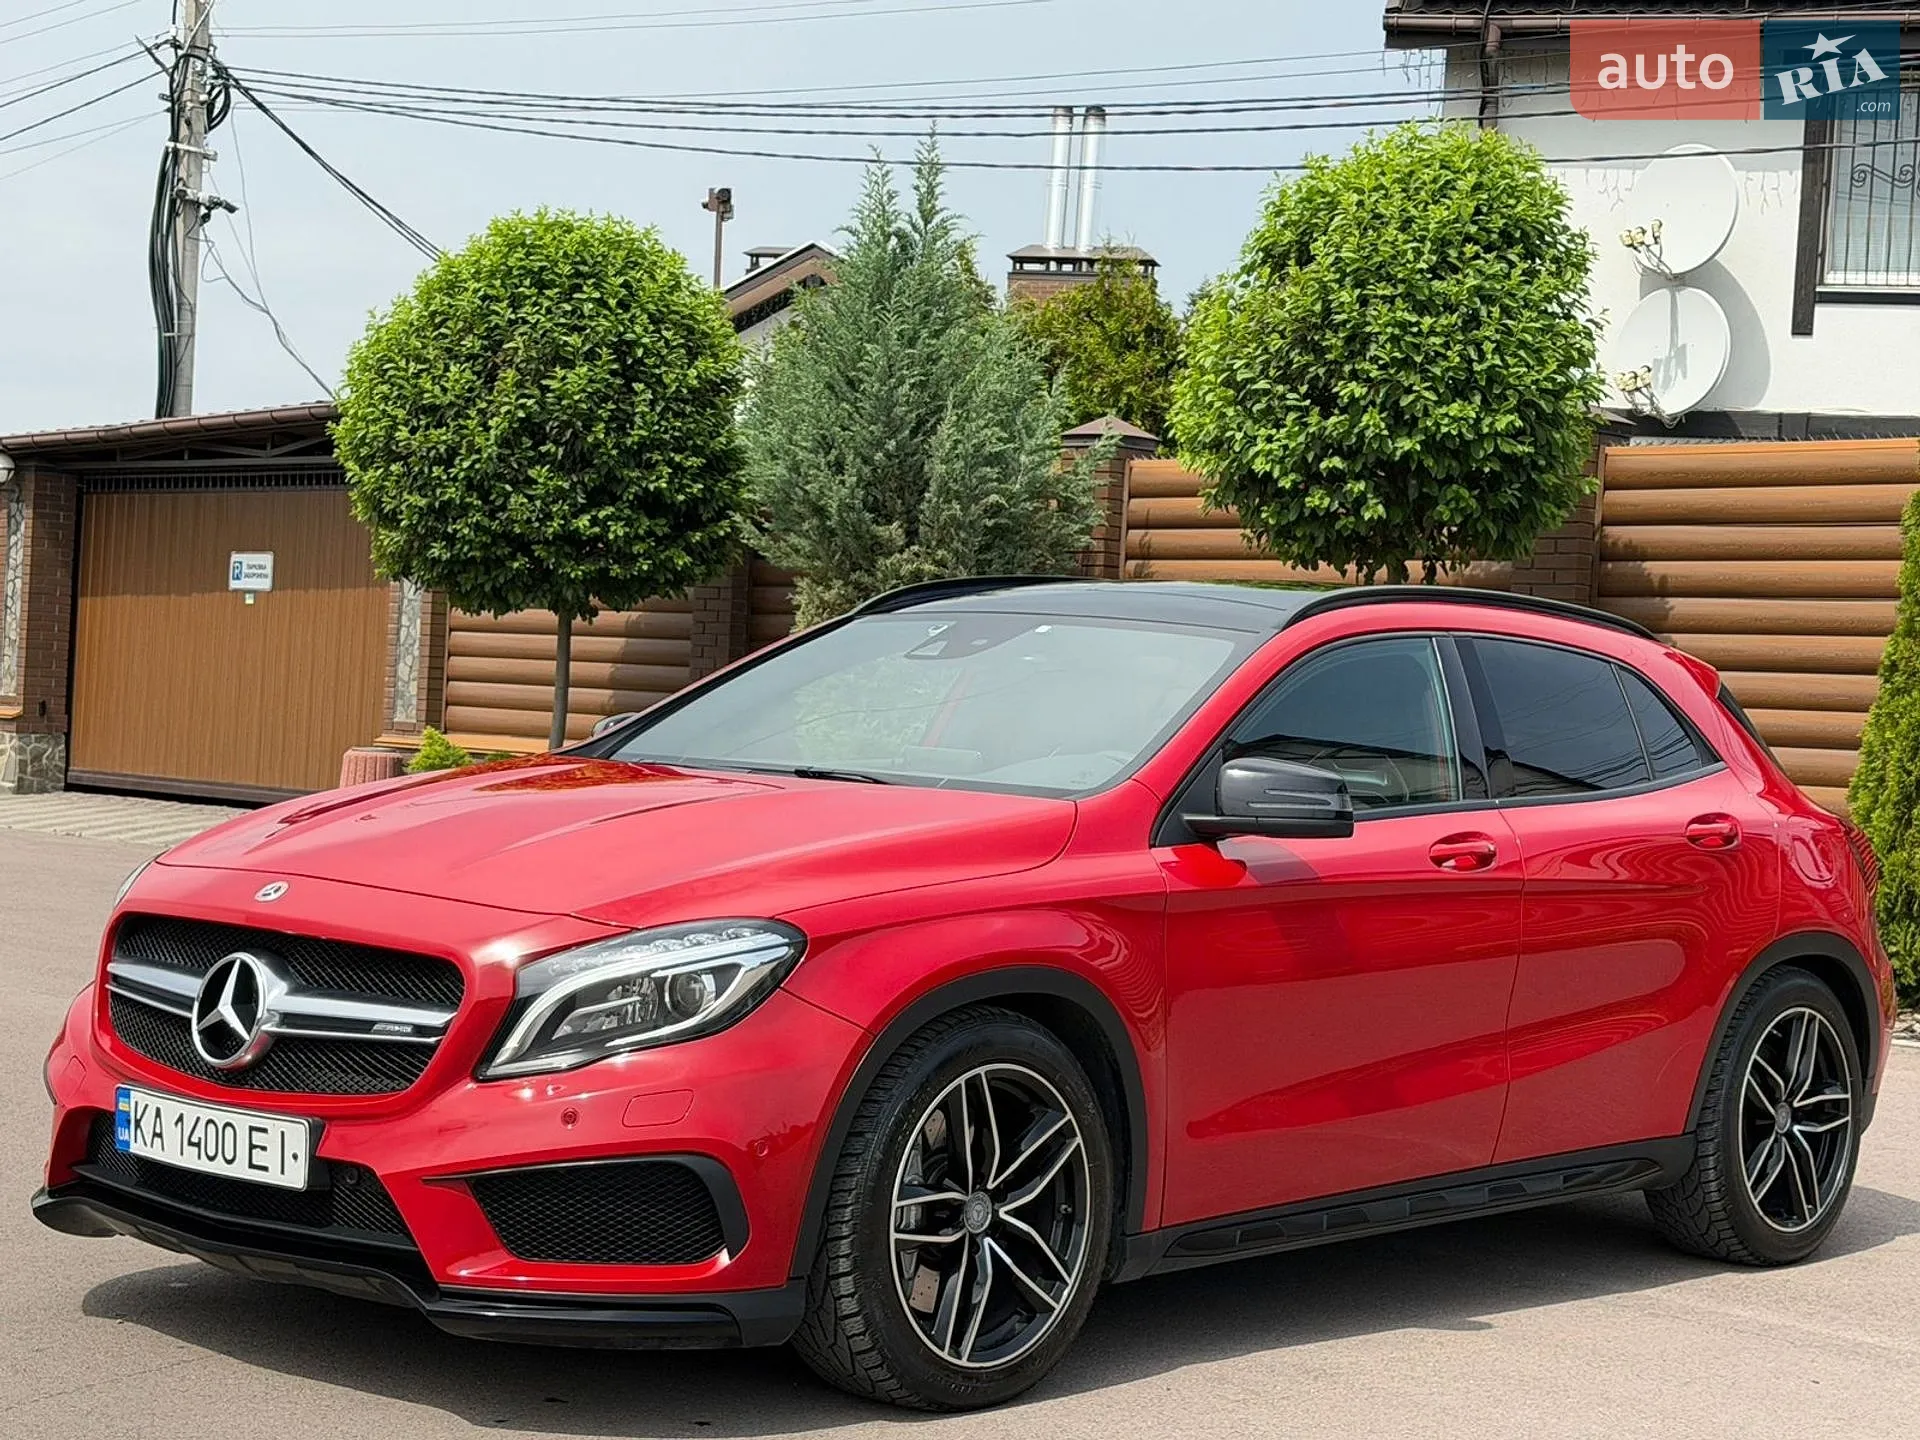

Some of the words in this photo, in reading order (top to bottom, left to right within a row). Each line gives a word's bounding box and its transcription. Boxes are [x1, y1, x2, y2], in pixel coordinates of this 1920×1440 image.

[118, 1126, 131, 1142] UA
[134, 1100, 165, 1152] KA
[174, 1112, 237, 1165] 1400
[248, 1125, 286, 1175] EI
